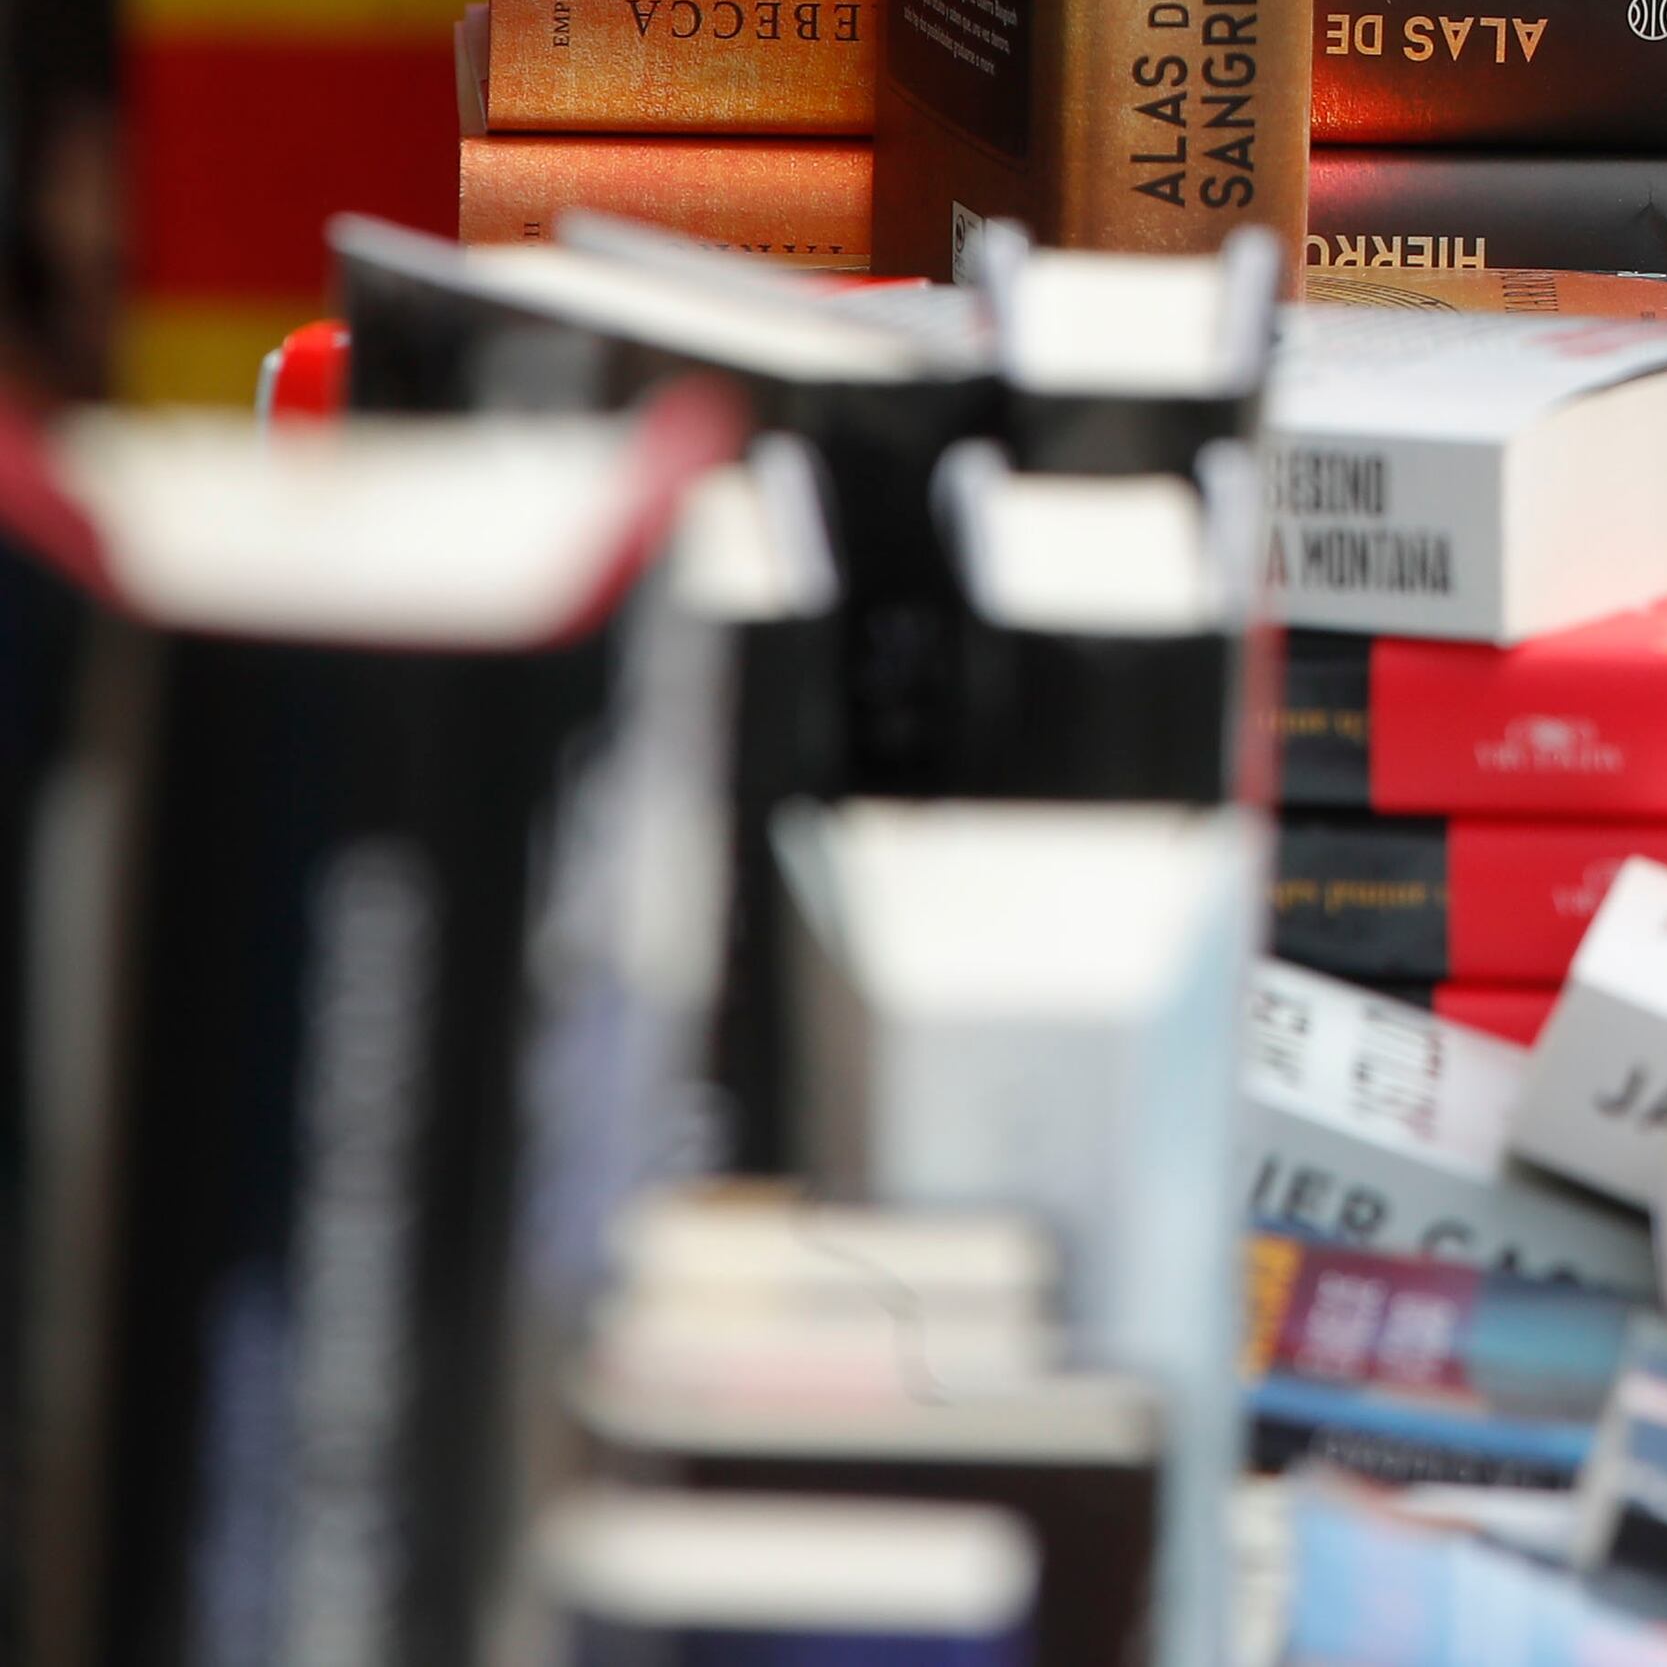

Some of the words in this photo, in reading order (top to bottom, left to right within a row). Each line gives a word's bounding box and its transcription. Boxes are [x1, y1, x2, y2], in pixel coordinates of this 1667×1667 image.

[628, 0, 870, 41] EBECCA
[1325, 14, 1383, 56] DE
[1404, 15, 1549, 63] ALAS
[1130, 54, 1188, 208] ALAS
